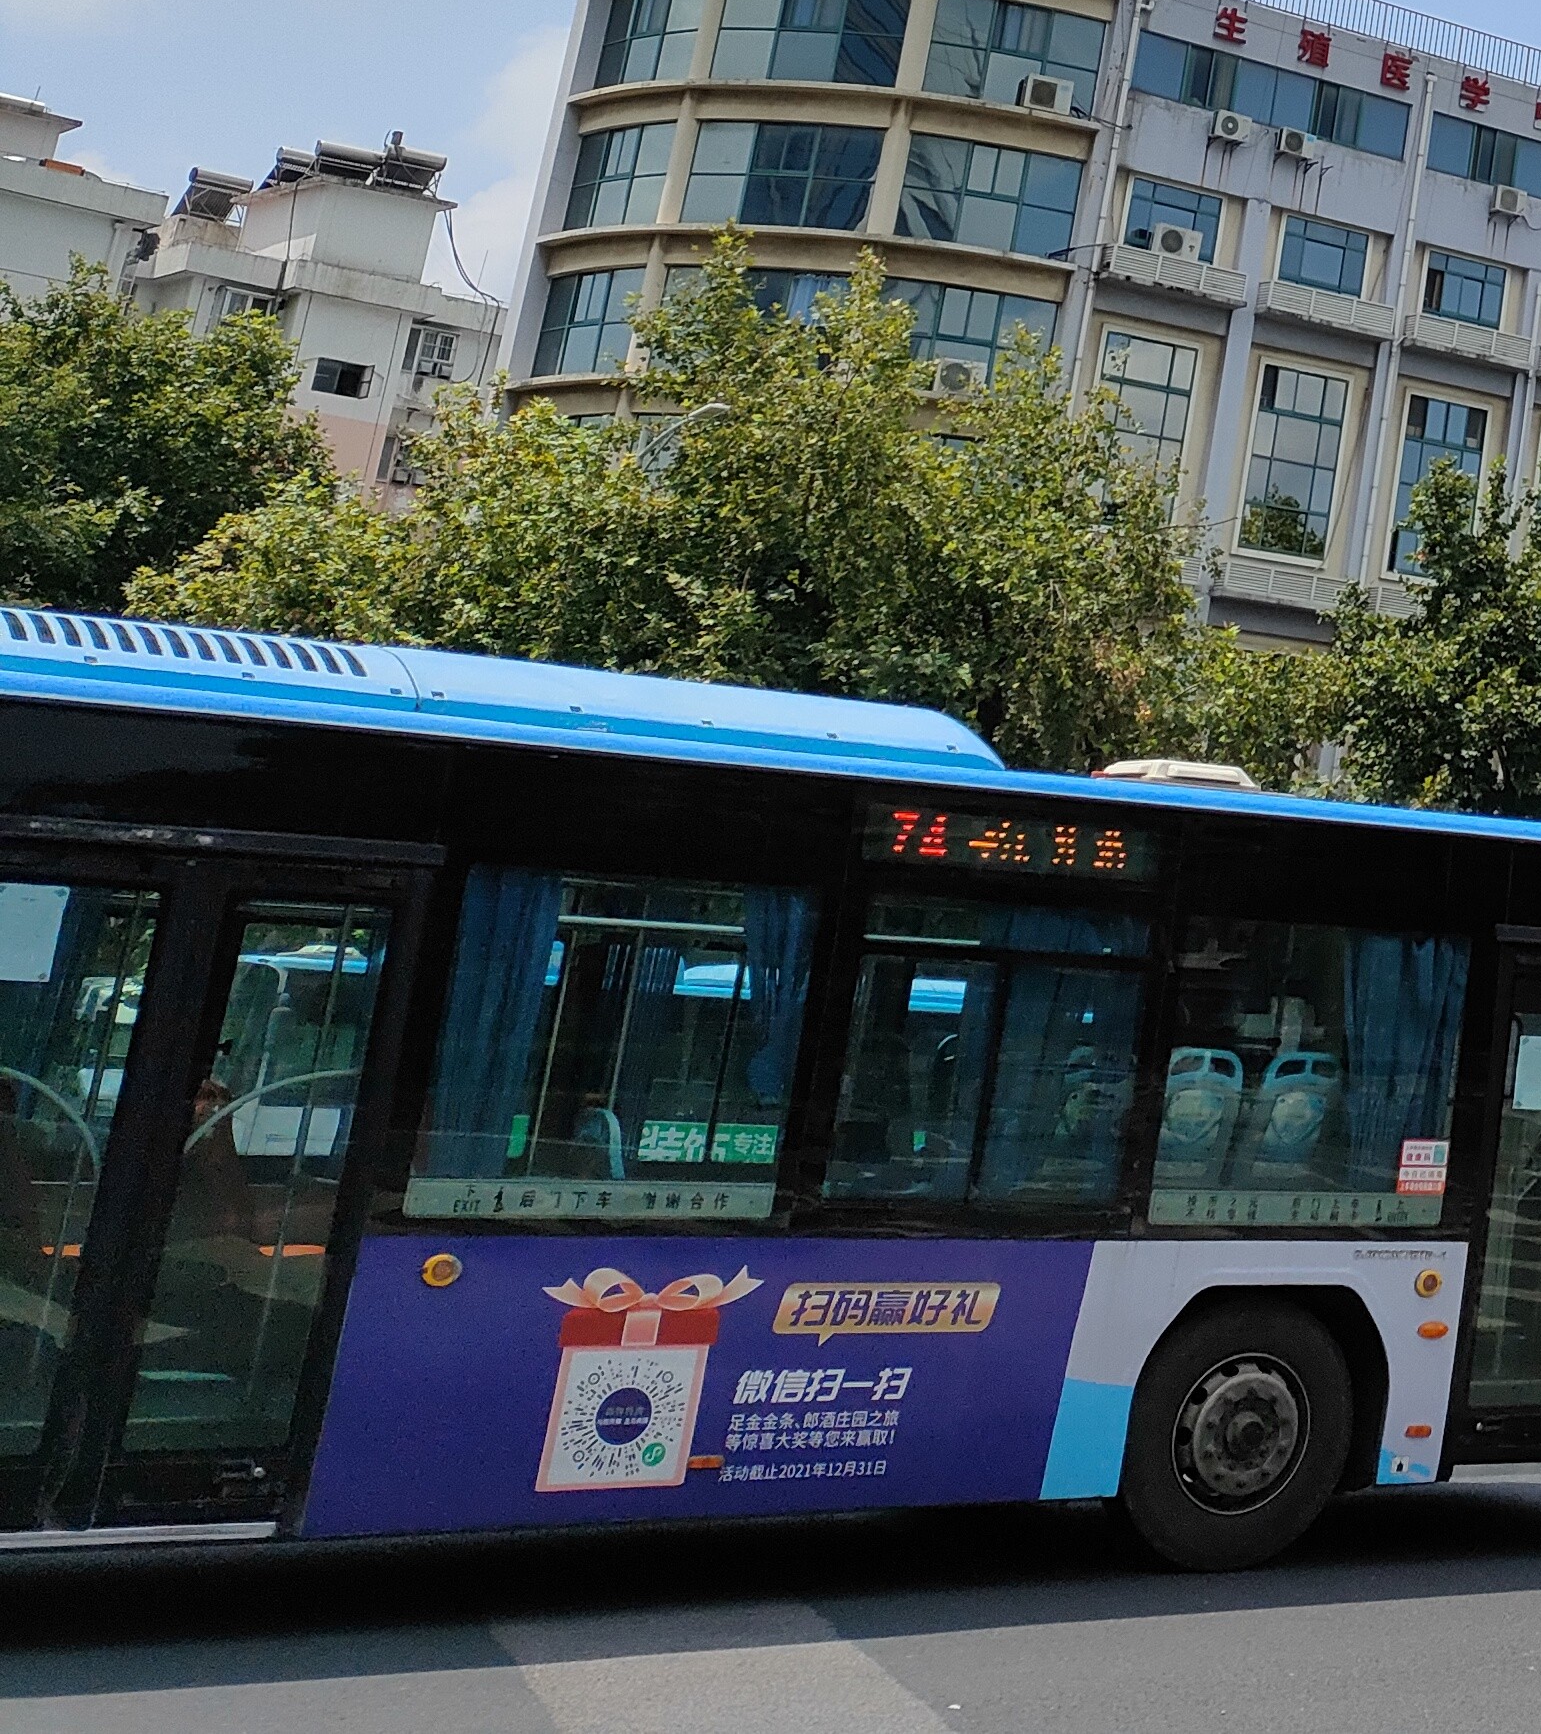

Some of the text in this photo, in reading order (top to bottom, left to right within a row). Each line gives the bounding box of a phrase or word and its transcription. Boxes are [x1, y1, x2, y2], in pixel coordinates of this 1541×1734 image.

[453, 1198, 482, 1215] EXIT
[788, 1289, 982, 1327] 扫码赢好礼
[732, 1367, 913, 1405] 微信扫一扫
[717, 1460, 888, 1483] 活动截止2021年12月31日
